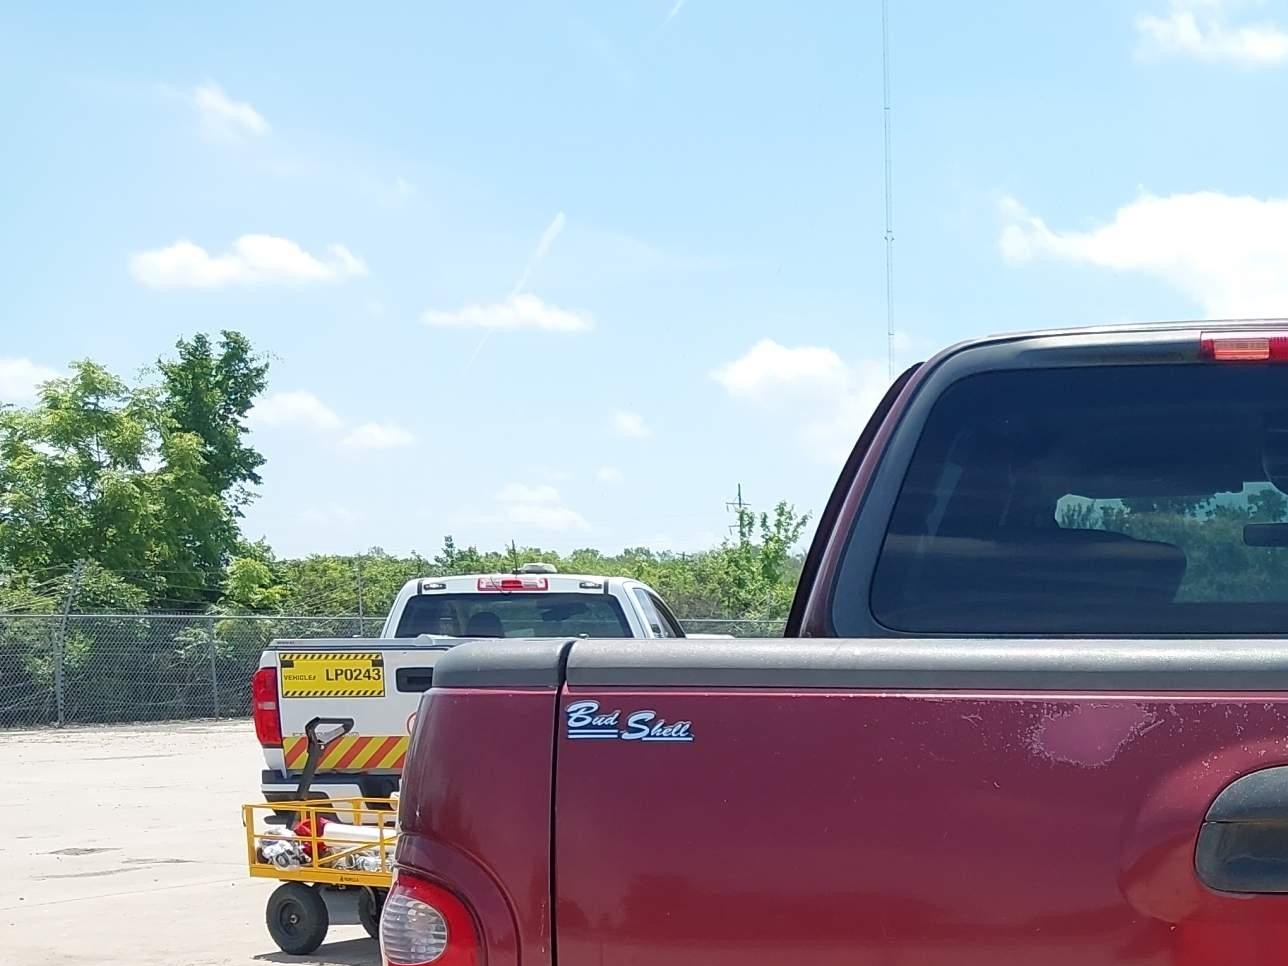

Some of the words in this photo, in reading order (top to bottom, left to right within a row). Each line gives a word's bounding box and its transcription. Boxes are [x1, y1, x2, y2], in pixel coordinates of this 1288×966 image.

[325, 668, 382, 681] LP0243
[566, 700, 621, 728] Bud
[621, 710, 692, 740] Shell
